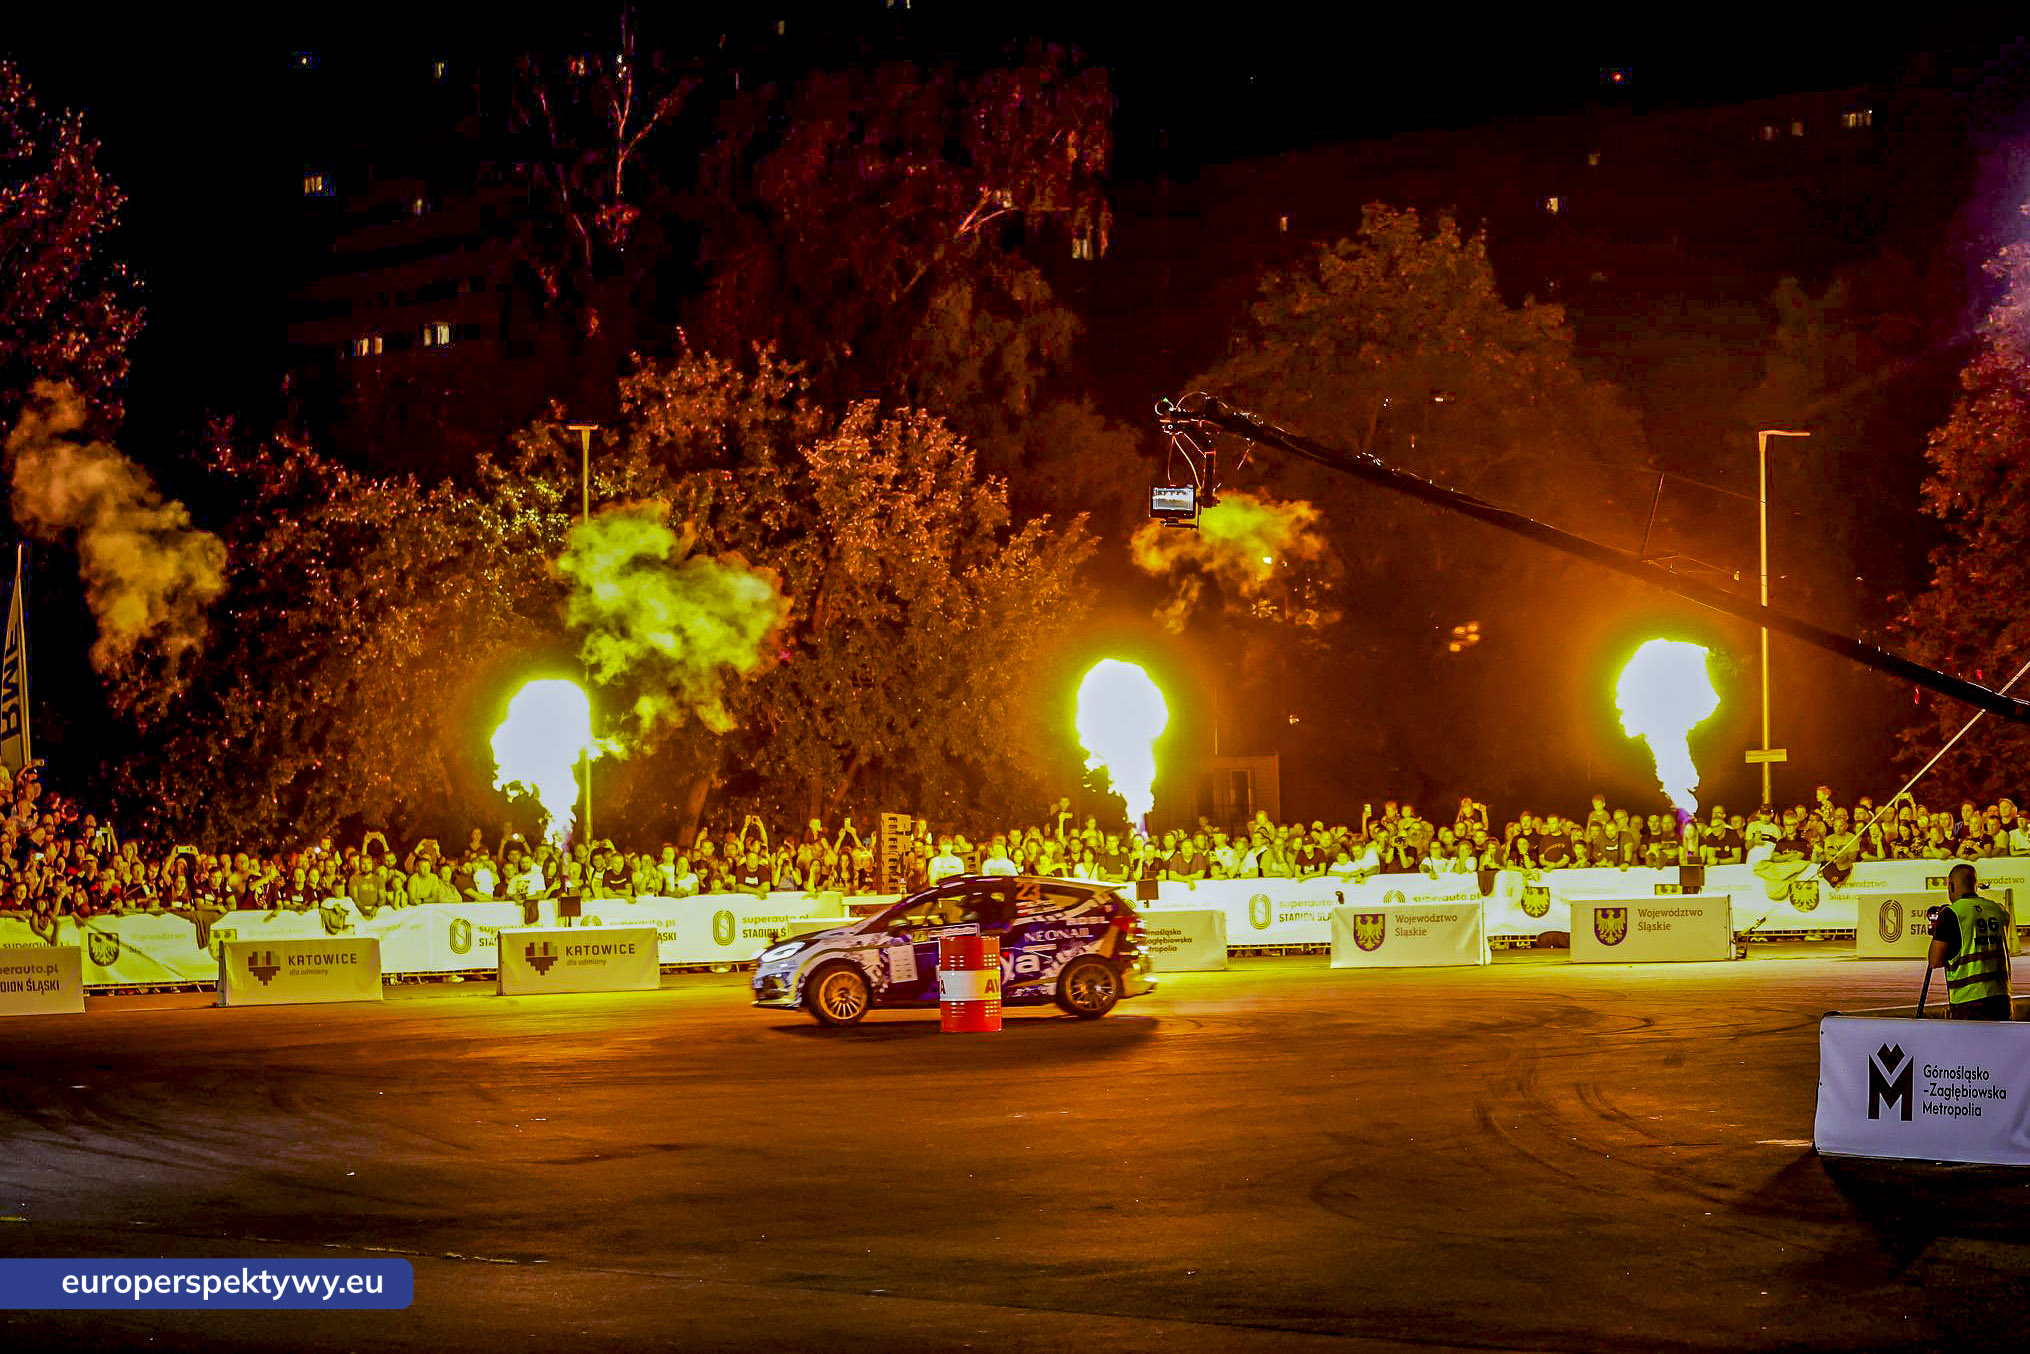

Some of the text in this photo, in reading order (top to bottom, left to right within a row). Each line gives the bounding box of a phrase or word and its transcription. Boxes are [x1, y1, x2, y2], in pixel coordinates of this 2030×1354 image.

[1976, 916, 1999, 934] 96
[566, 943, 636, 957] KATOWICE
[288, 953, 358, 967] KATOWICE
[26, 977, 60, 996] ŚLĄSKI
[1923, 1064, 1990, 1083] Górnośląsko
[1923, 1083, 2007, 1101] -Zagłębiowska
[1922, 1101, 1982, 1120] Metropolia
